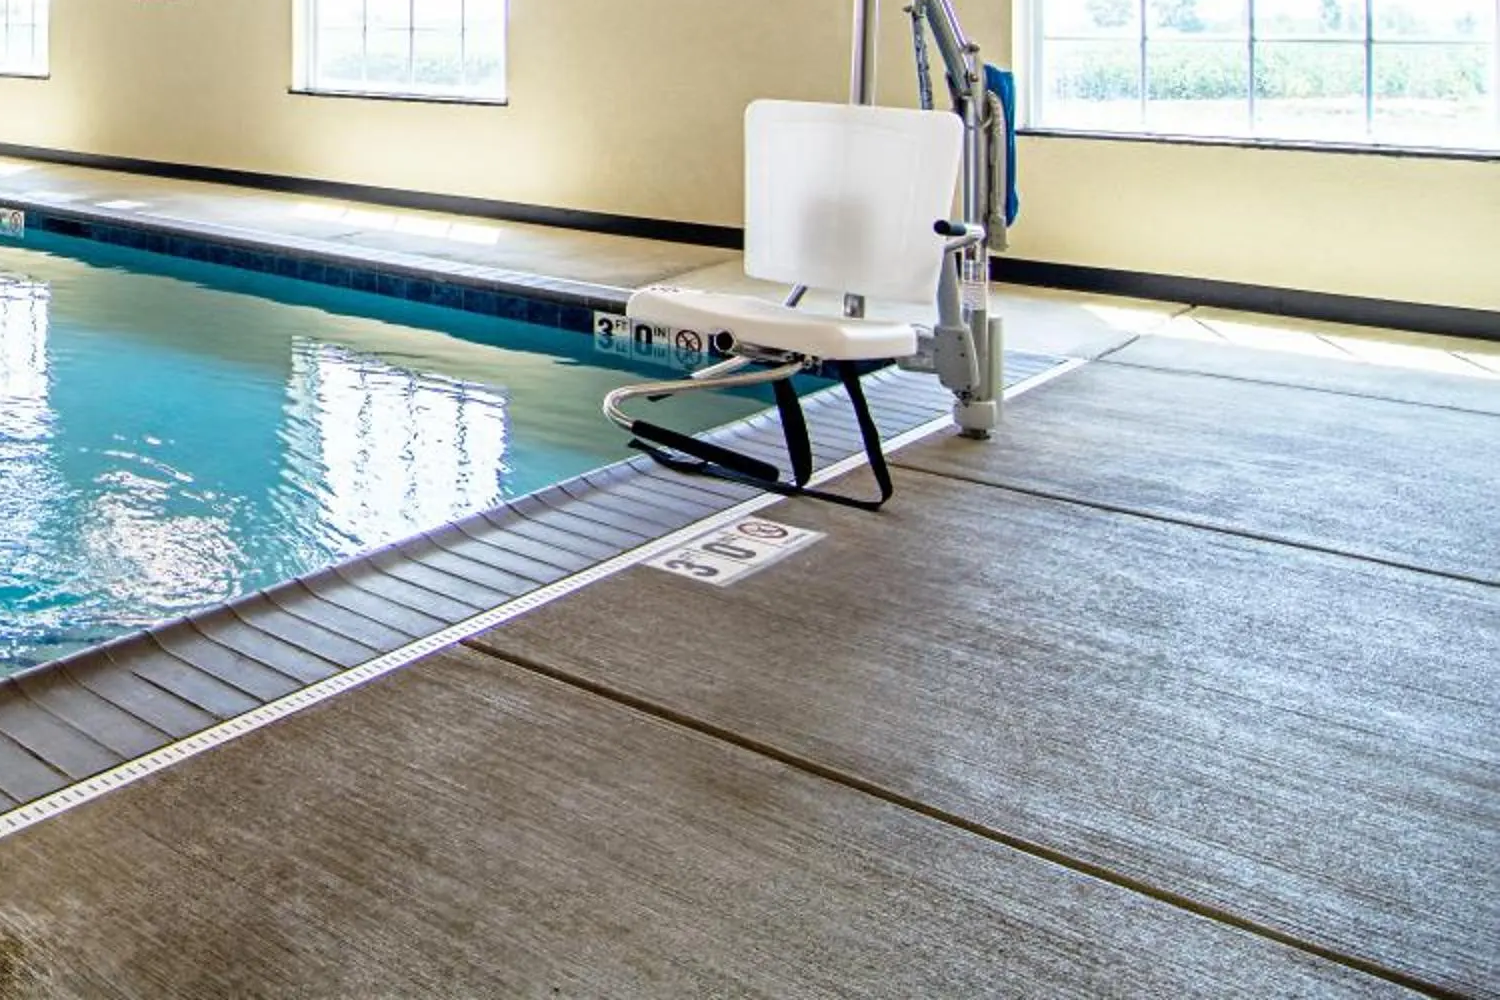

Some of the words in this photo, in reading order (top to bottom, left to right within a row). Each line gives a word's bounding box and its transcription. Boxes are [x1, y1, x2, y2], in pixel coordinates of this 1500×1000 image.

[598, 318, 613, 337] 3
[616, 320, 628, 331] FT
[654, 327, 666, 338] IN
[665, 559, 719, 577] 3
